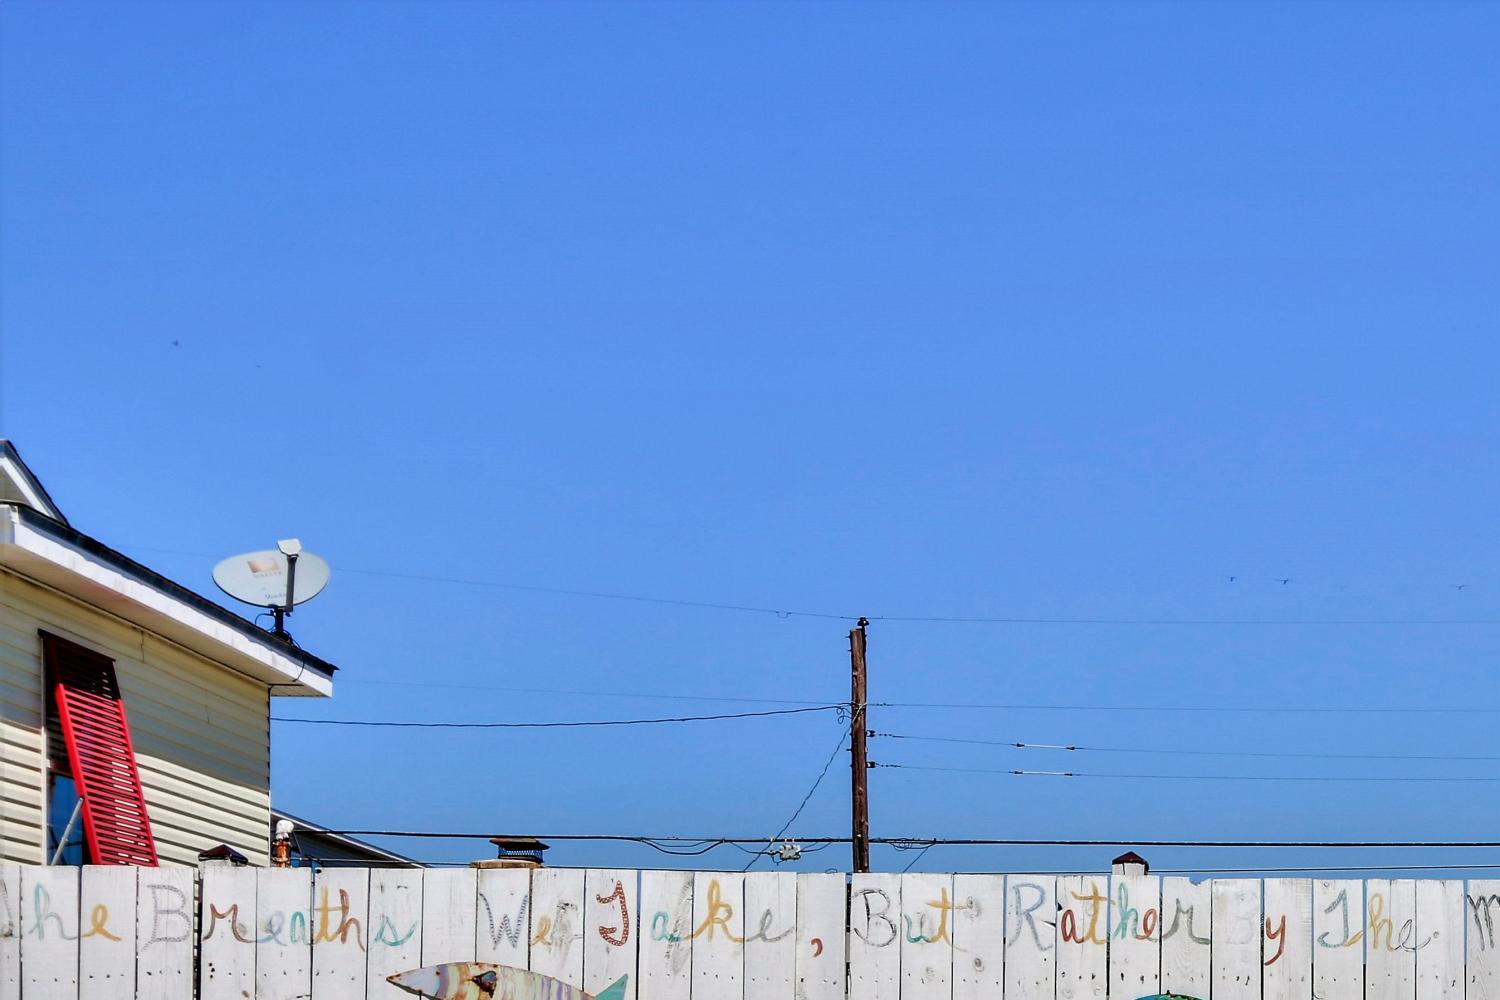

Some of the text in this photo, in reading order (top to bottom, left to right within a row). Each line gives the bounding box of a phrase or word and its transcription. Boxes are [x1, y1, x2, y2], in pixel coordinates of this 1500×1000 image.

[479, 892, 553, 951] We
[853, 885, 968, 952] But
[1006, 881, 1212, 952] Rather
[1317, 886, 1431, 953] The
